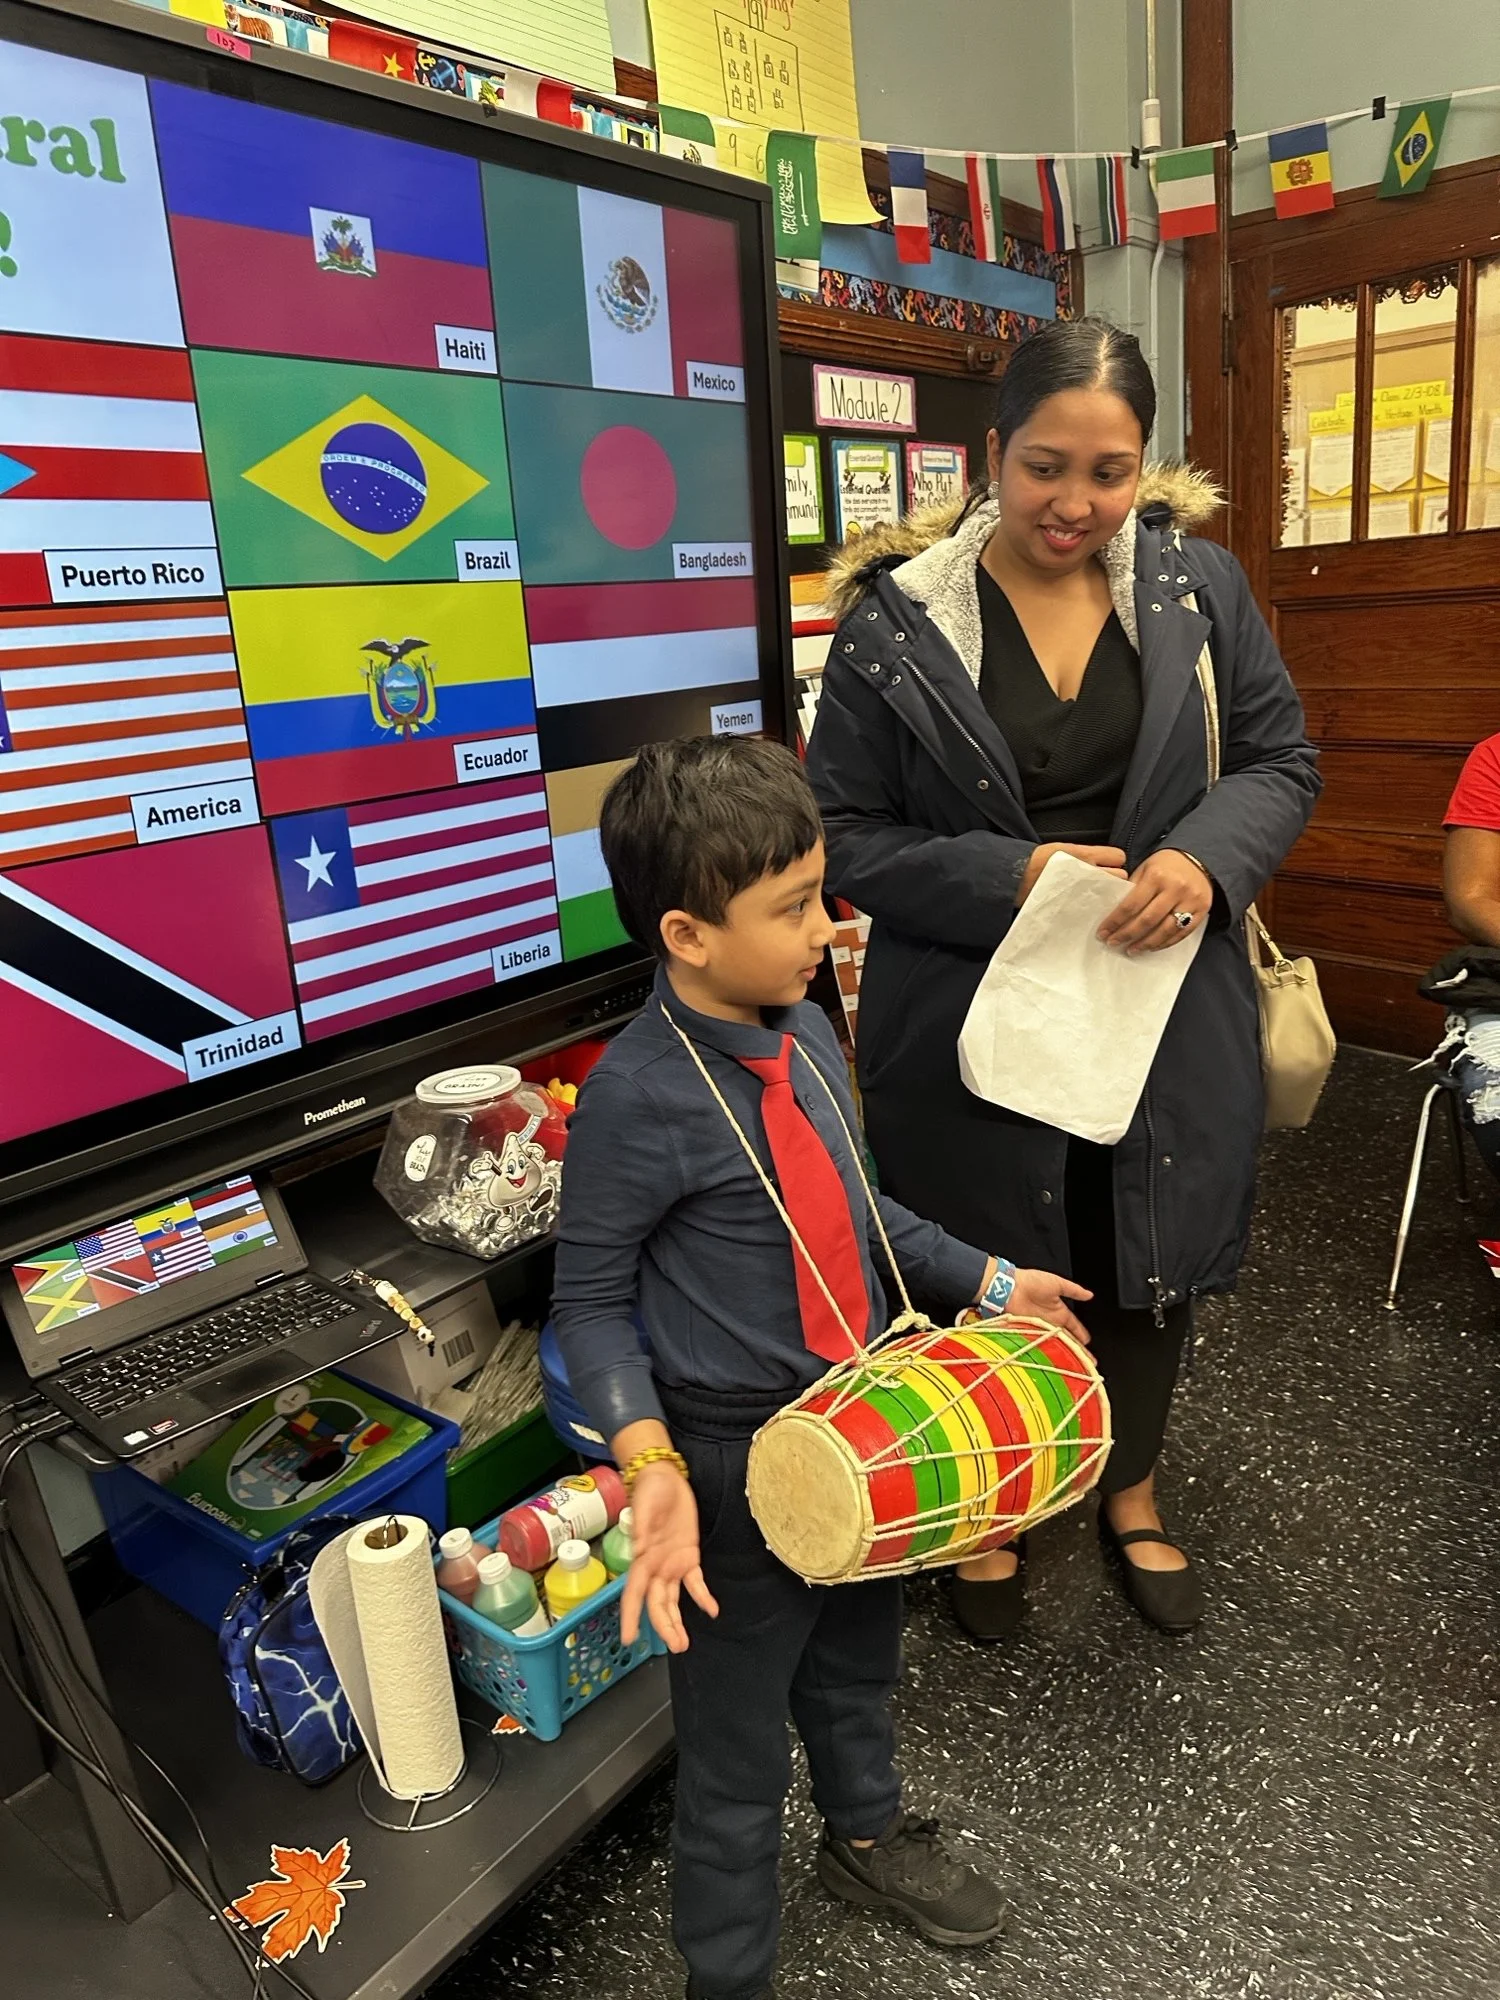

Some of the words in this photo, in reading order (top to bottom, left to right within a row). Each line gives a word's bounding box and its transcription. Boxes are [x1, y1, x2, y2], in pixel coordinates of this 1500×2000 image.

[216, 32, 236, 52] 103
[728, 132, 738, 167] 9
[445, 337, 487, 362] Haiti
[693, 371, 737, 393] Mexico
[830, 376, 890, 423] Module
[891, 382, 903, 426] 2
[323, 454, 357, 462] ORDEM
[371, 460, 426, 492] PROGRESSO
[911, 470, 933, 492] Who
[465, 551, 511, 571] Brazil
[679, 551, 747, 572] Bangladesh
[61, 565, 148, 588] Puerto
[152, 563, 206, 585] Rico
[716, 711, 754, 729] Yemen
[463, 745, 530, 771] Ecuador
[146, 794, 242, 829] America
[499, 940, 552, 971] Liberia
[195, 1026, 285, 1069] Trinidad
[303, 1096, 366, 1126] Promethean
